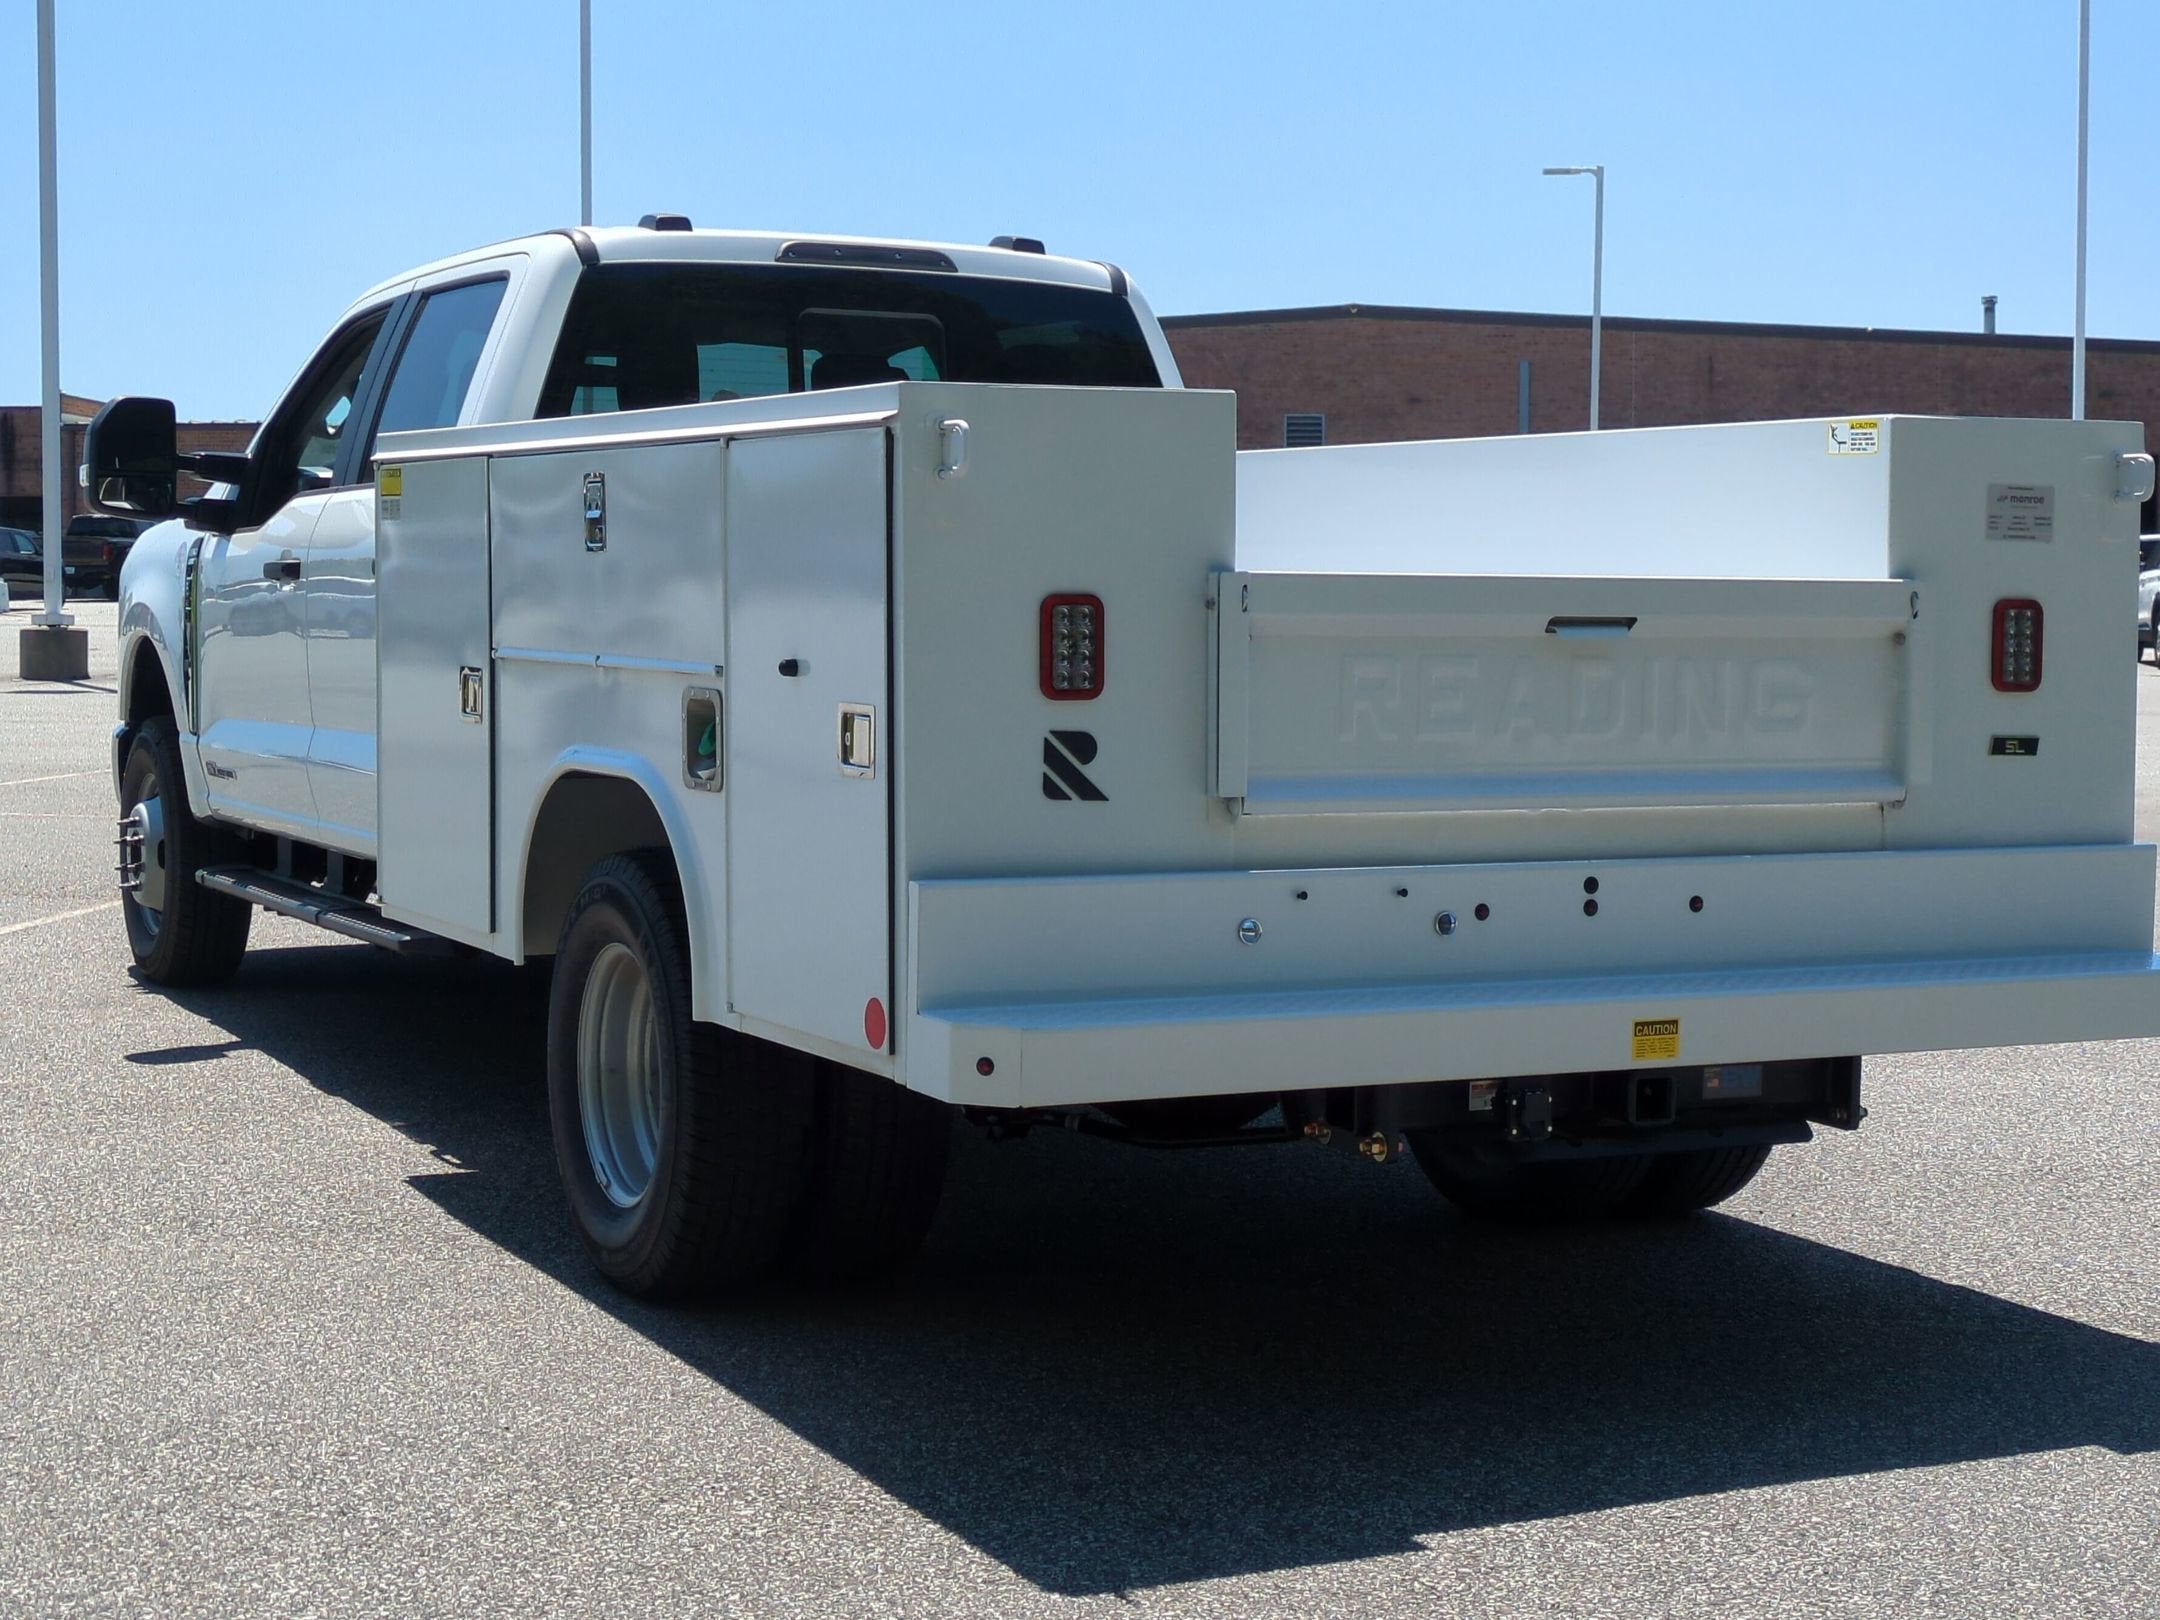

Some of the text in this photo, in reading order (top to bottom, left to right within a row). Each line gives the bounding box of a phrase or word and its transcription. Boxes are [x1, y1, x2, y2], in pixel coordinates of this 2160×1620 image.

[1337, 654, 1815, 741] READING
[2005, 741, 2025, 753] SL
[1636, 1023, 1677, 1036] CAUTION
